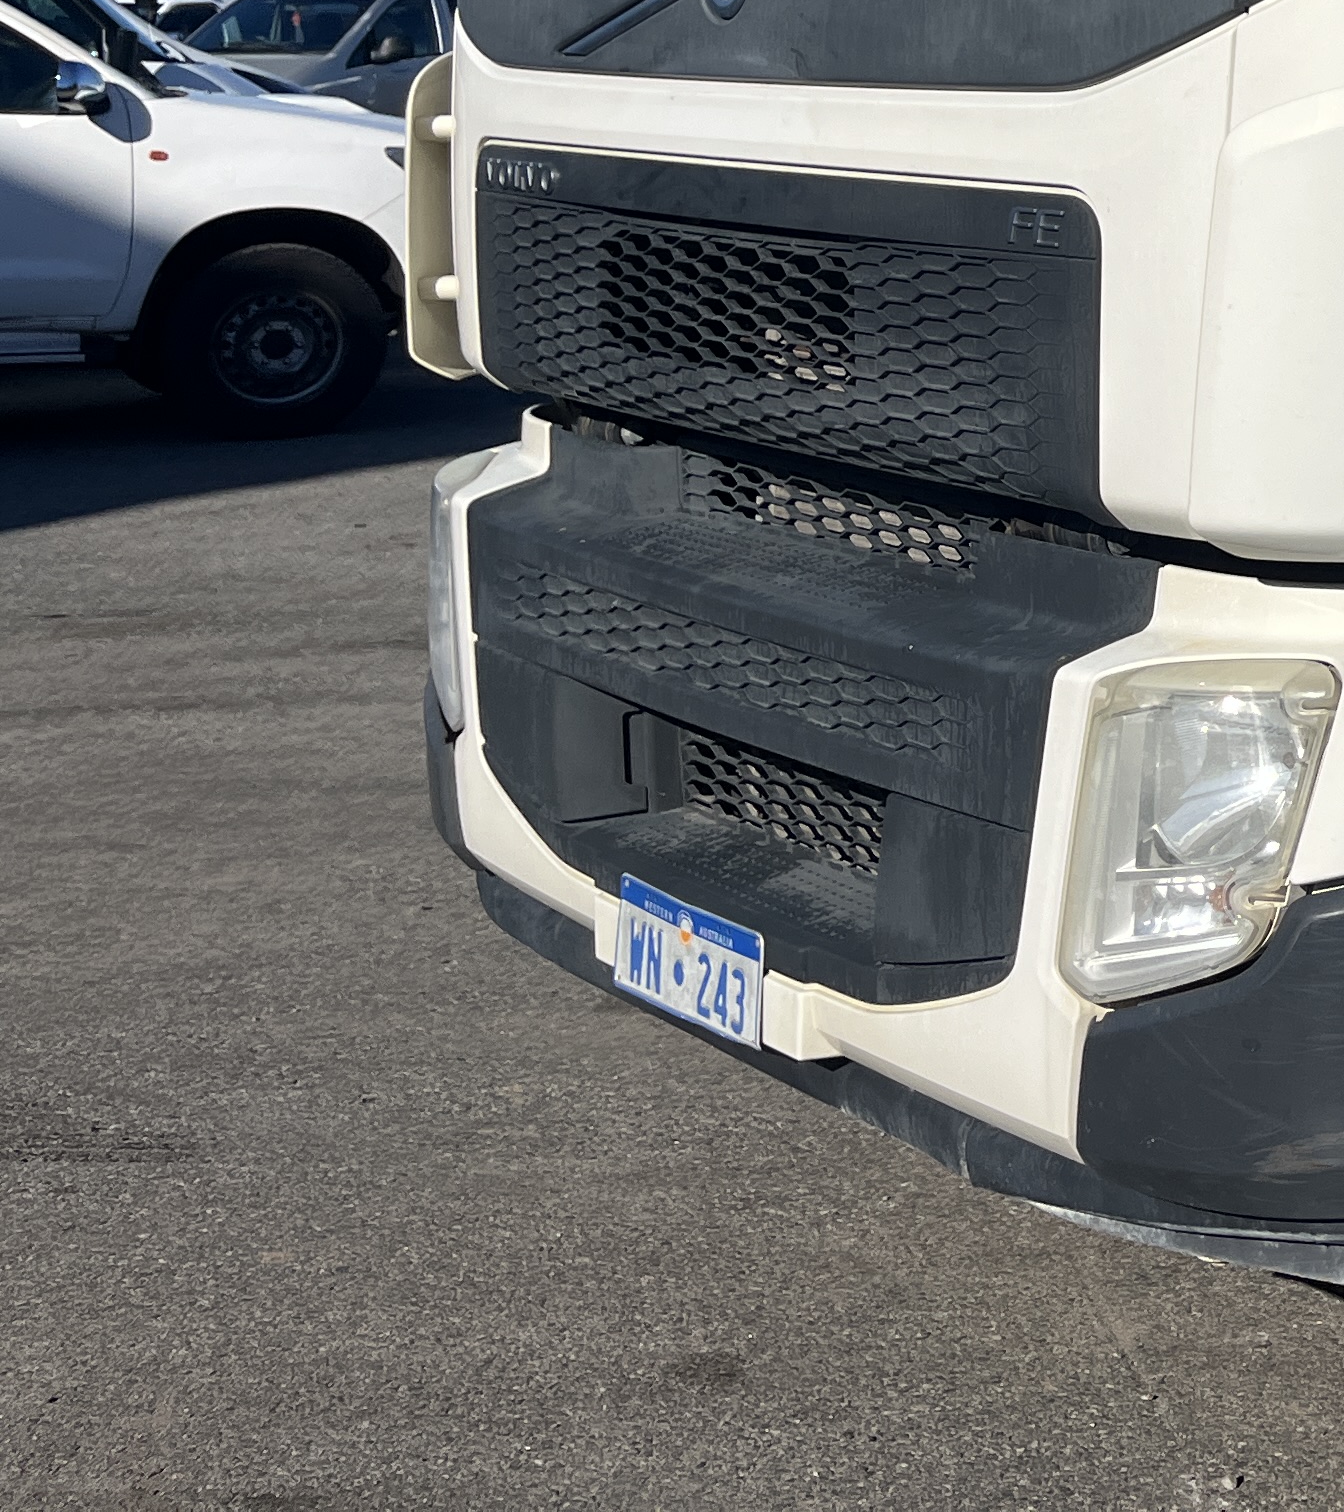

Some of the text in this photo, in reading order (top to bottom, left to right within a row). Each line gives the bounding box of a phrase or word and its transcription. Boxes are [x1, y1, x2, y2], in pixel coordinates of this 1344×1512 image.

[1007, 206, 1065, 249] FE
[643, 899, 734, 949] WESTERN AUSTRALIA
[629, 916, 746, 1036] WN 243
